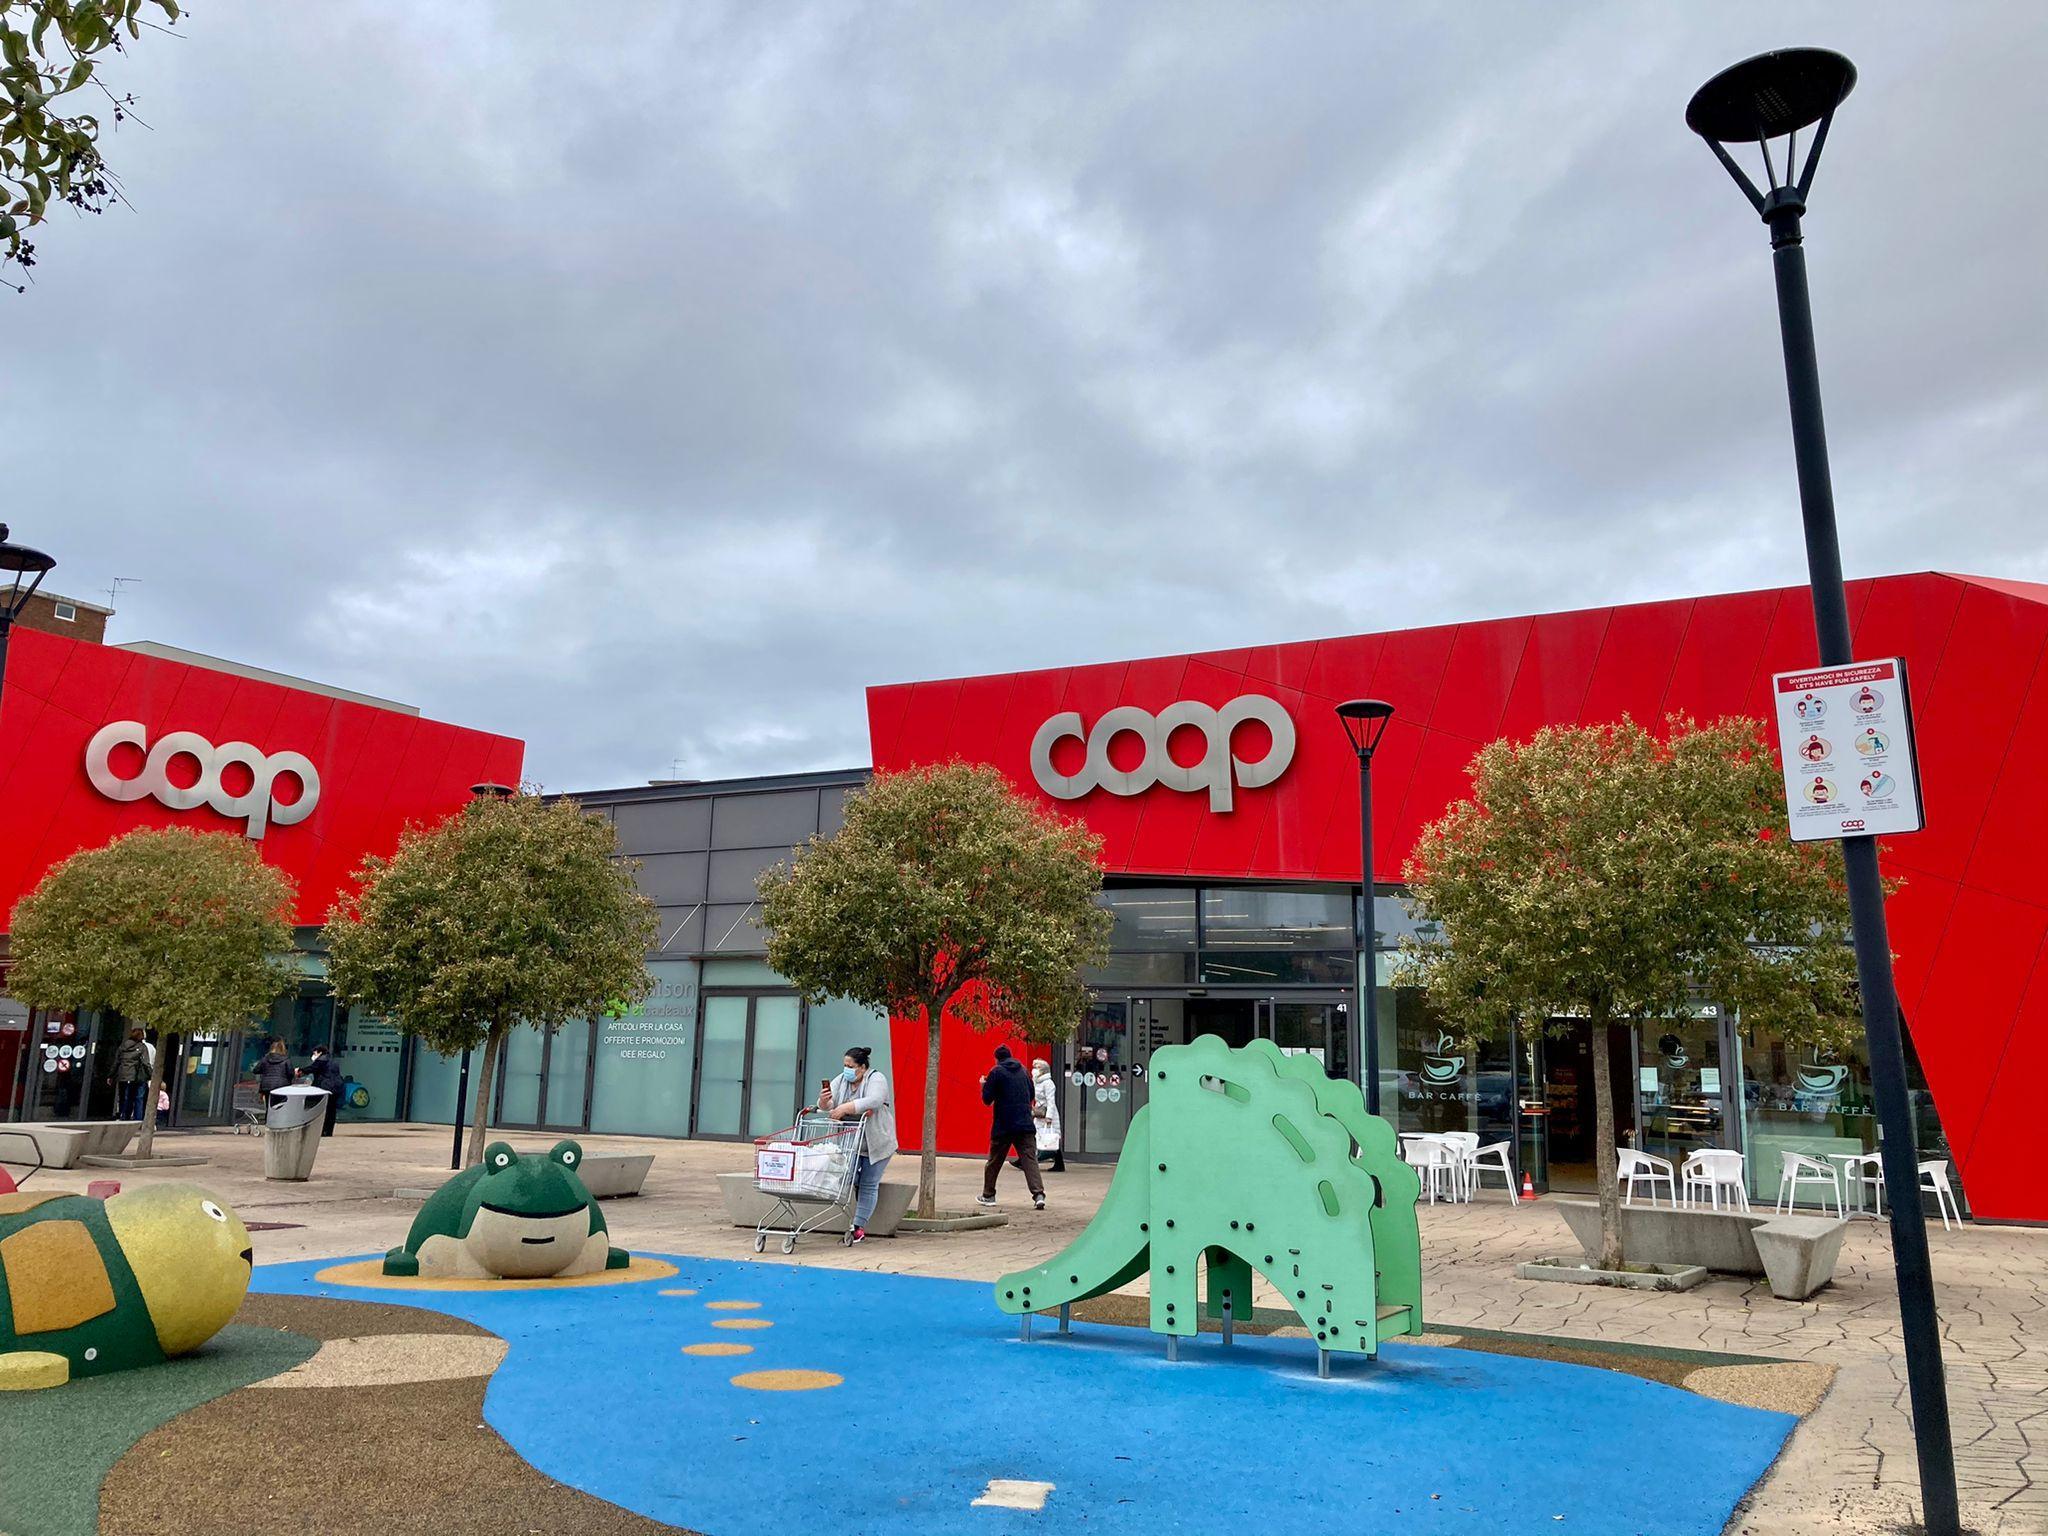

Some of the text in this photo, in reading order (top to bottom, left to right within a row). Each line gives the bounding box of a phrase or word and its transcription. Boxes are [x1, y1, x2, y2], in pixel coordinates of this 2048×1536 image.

[1789, 674, 1835, 684] DIVERTIAMOCI
[1844, 667, 1881, 677] SICUREZZA
[1795, 681, 1814, 689] LET'S
[1851, 674, 1876, 683] SAFELY
[1030, 694, 1296, 813] coop
[85, 720, 321, 839] coop
[1841, 819, 1865, 828] coop
[1336, 1003, 1347, 1012] 41
[1701, 1006, 1718, 1016] 43
[607, 1023, 683, 1031] ARTICOLI PER LA CASA
[603, 1036, 634, 1045] OFFERTE
[641, 1037, 686, 1045] PROMOZIONI
[620, 1050, 666, 1059] IDEE REGALO
[1408, 1091, 1434, 1100] BAR
[1778, 1103, 1871, 1115] BAR CAFFÈ
